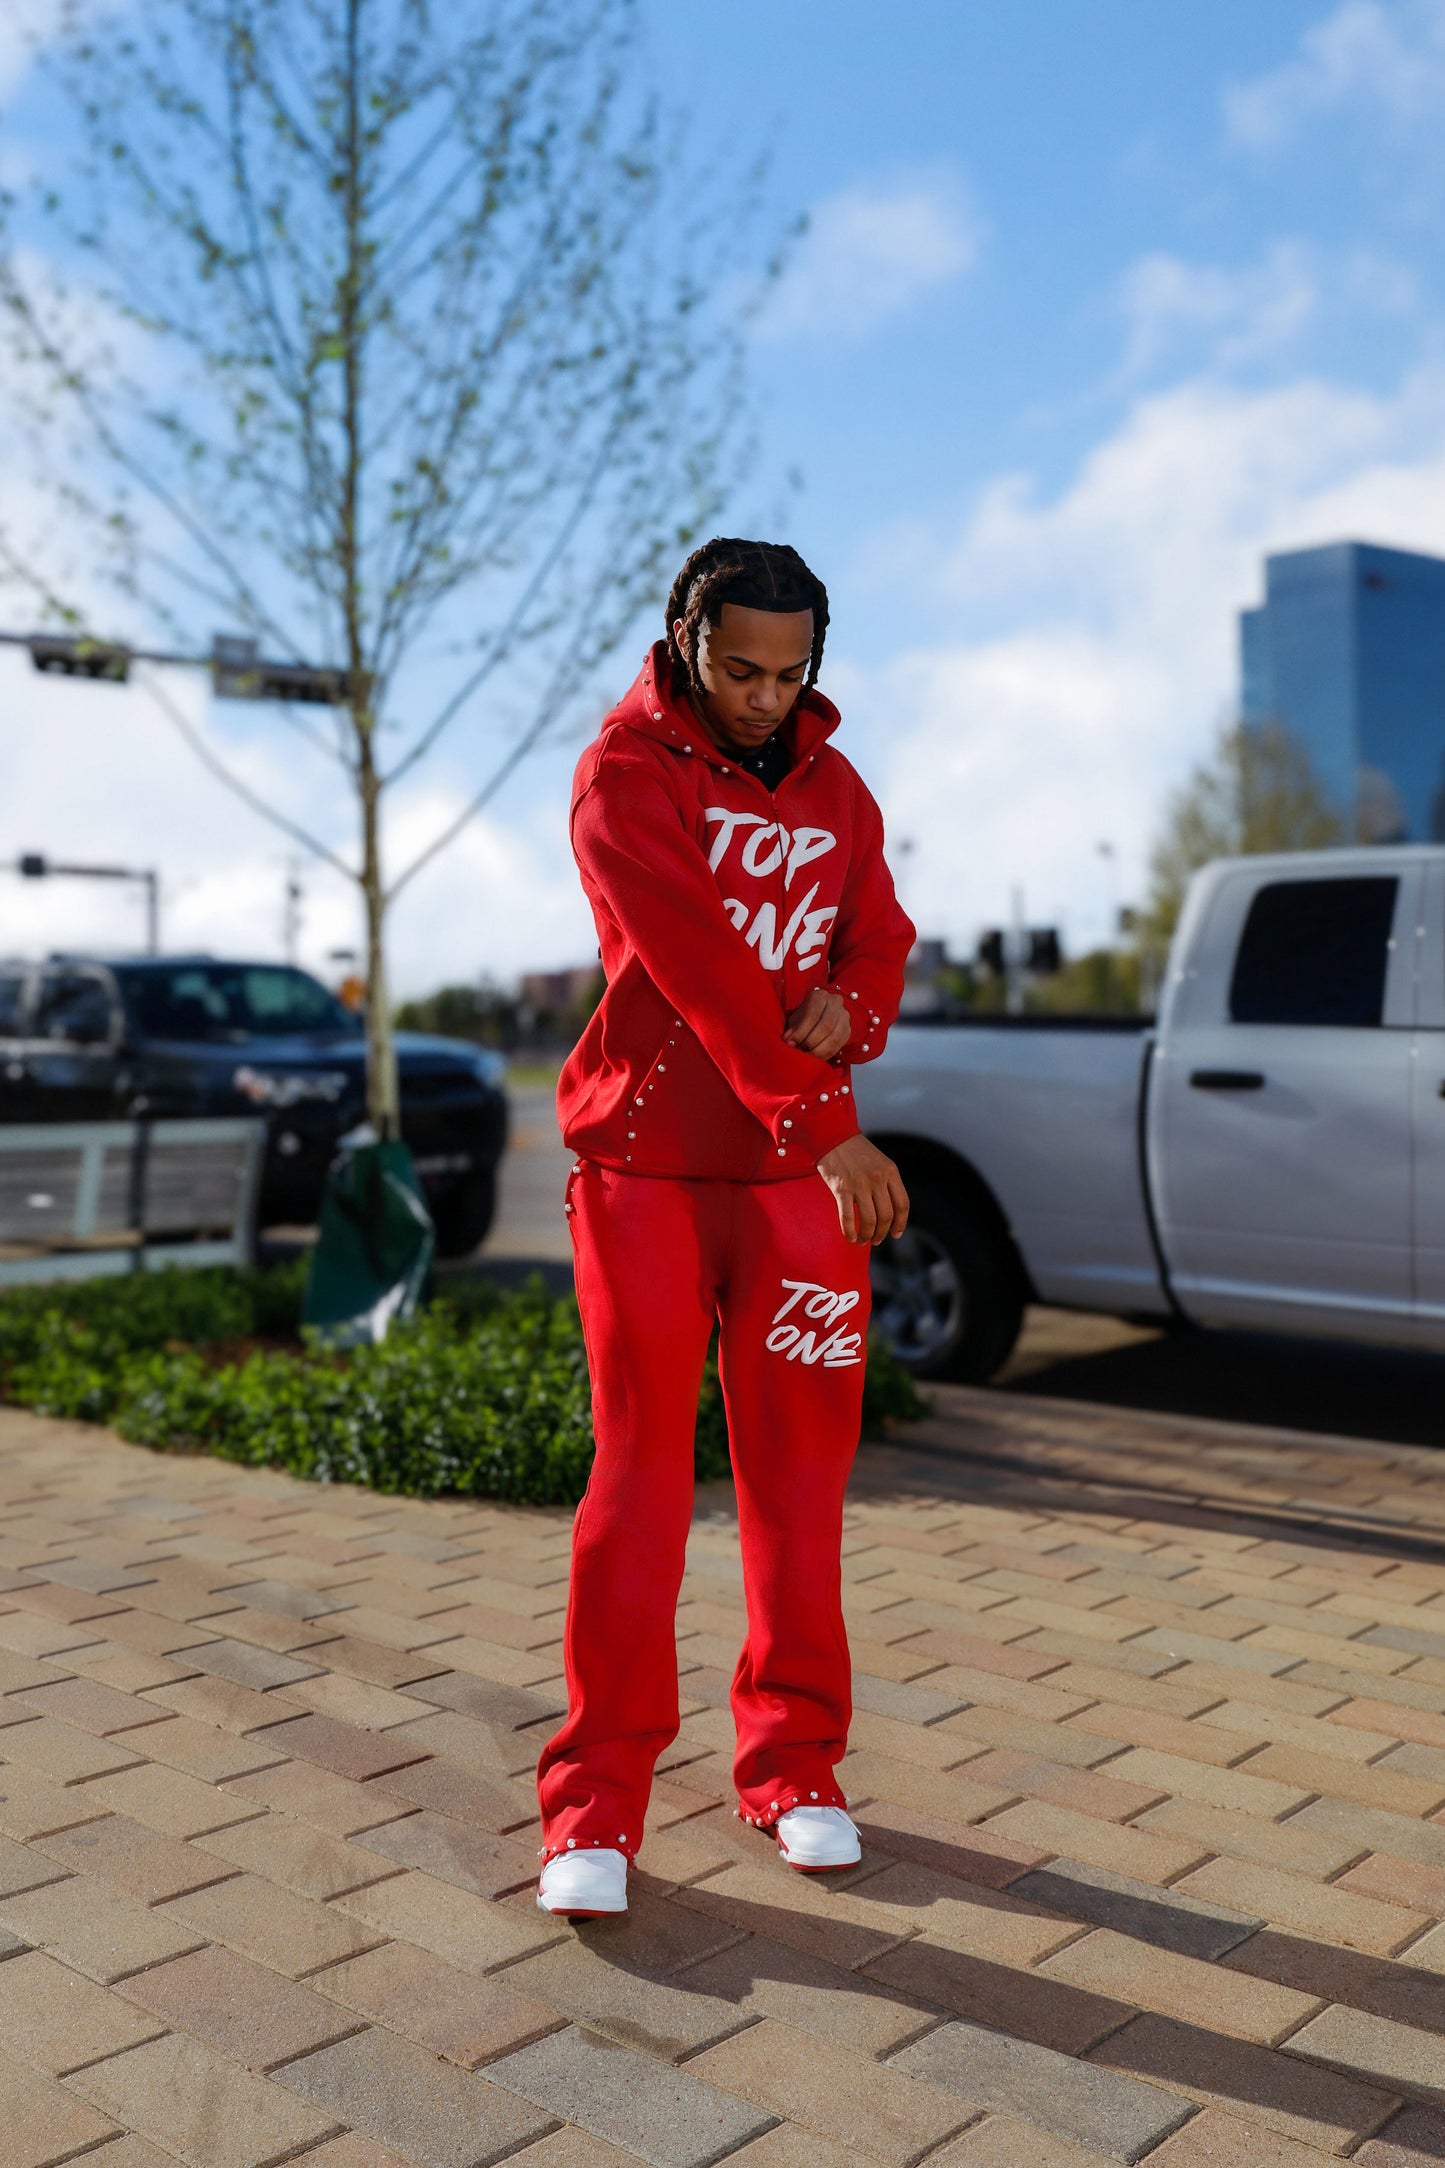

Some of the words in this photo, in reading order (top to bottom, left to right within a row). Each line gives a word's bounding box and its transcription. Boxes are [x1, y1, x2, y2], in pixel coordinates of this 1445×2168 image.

[704, 806, 837, 892] TOP
[772, 1278, 860, 1329] TOP
[765, 1322, 861, 1368] ONE
